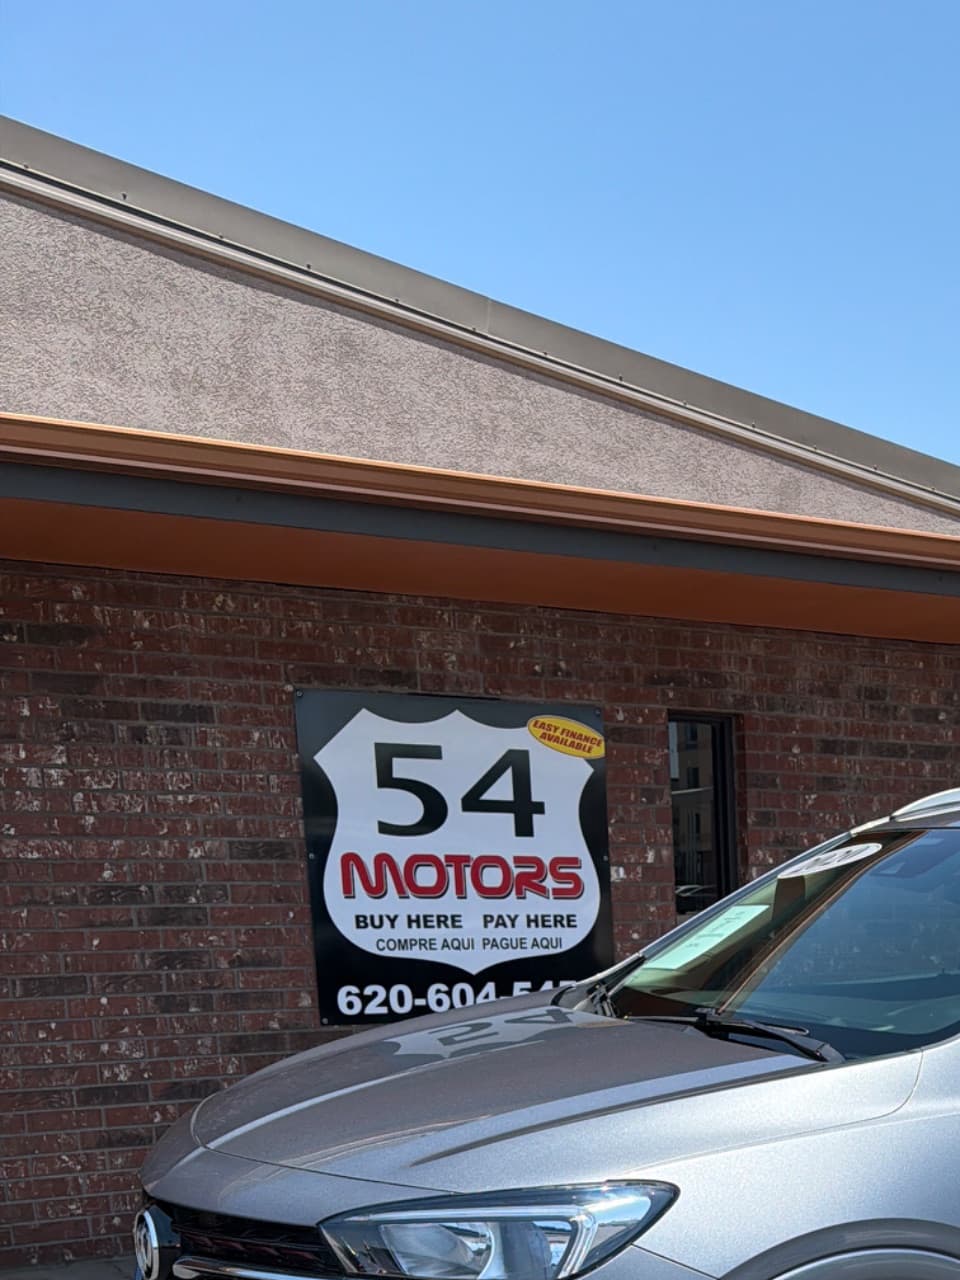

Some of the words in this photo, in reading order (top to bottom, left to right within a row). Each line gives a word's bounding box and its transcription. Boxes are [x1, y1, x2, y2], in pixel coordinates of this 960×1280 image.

[532, 720, 560, 733] EASY
[560, 728, 603, 747] FINANCE
[539, 732, 594, 754] AVAILABLE
[374, 742, 545, 837] 54
[340, 852, 584, 900] MOTORS
[354, 914, 399, 929] BUY
[406, 914, 463, 929] HERE
[482, 914, 519, 929] PAY
[526, 914, 578, 929] HERE
[376, 938, 438, 951] COMPRE
[441, 938, 475, 952] AQUI
[482, 937, 528, 950] PAGUE
[531, 937, 562, 950] AQUI
[337, 980, 577, 1015] 620-604
